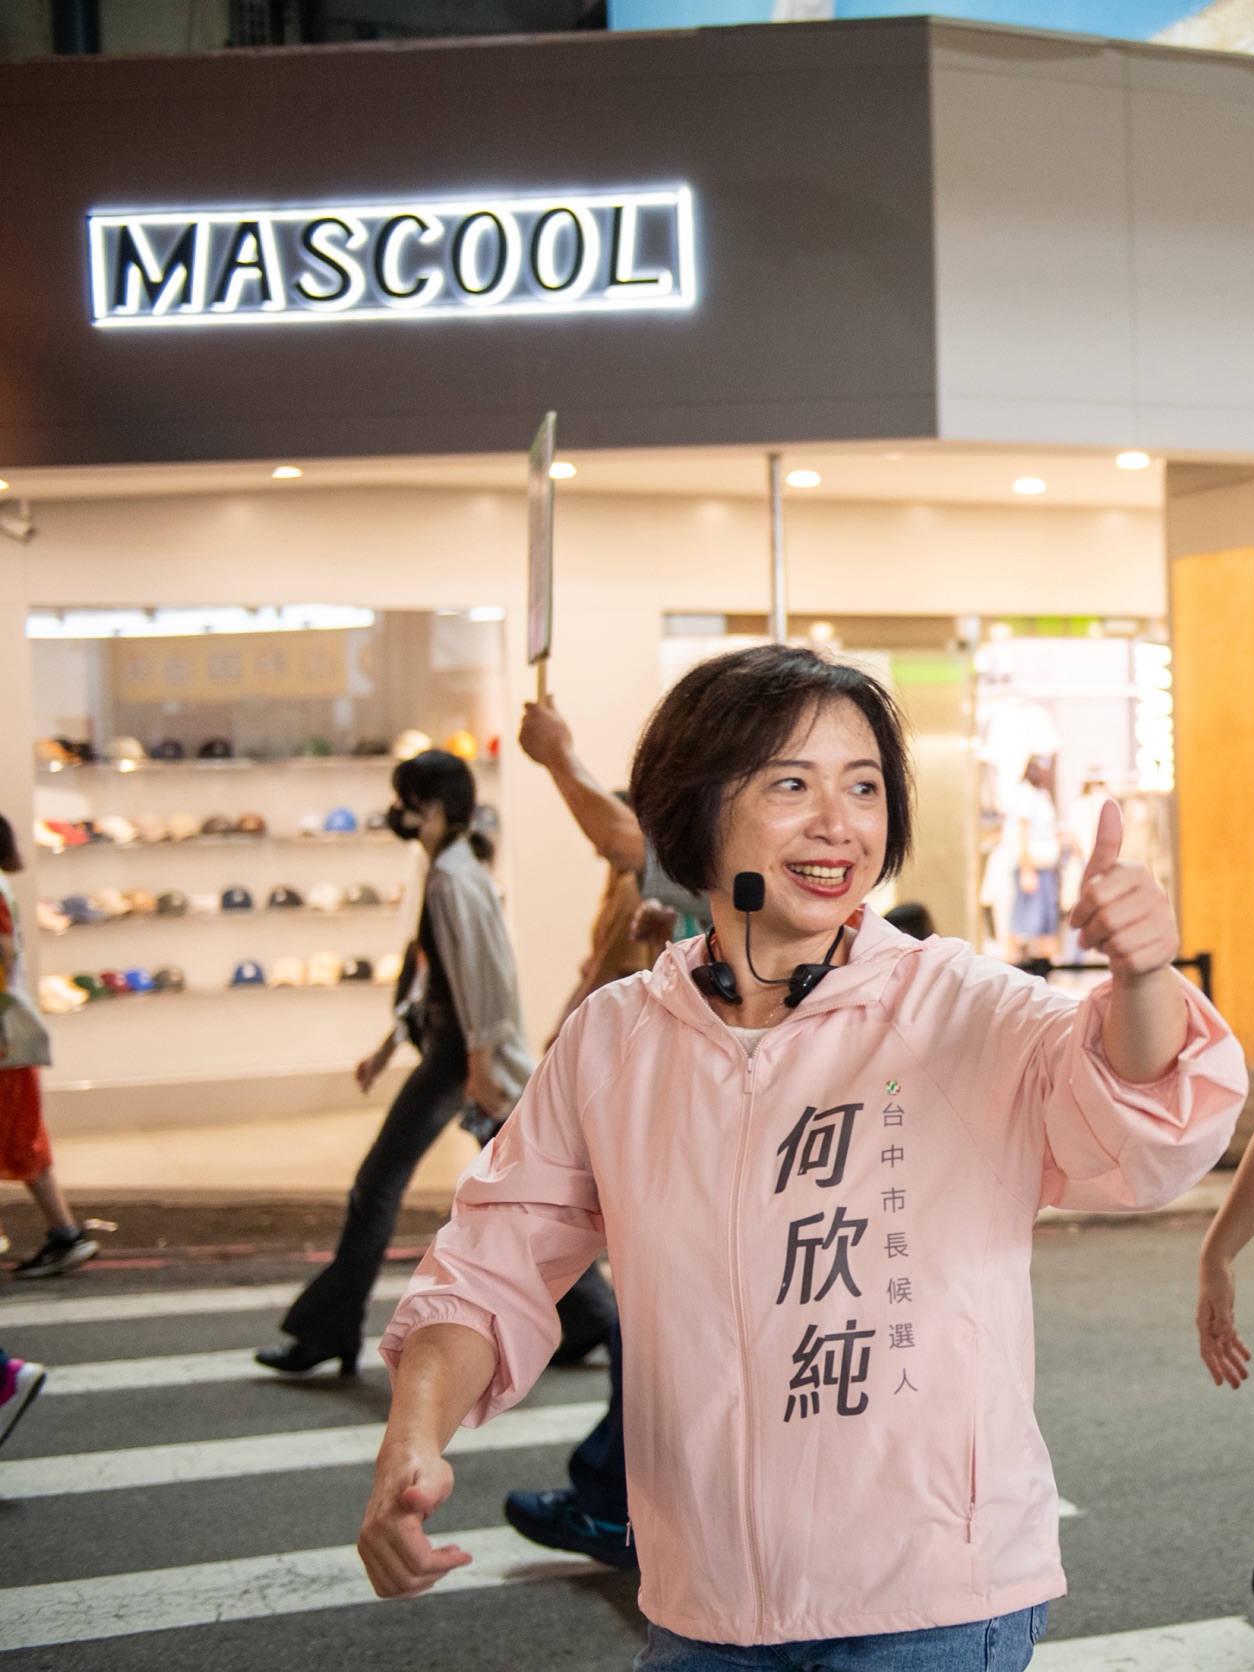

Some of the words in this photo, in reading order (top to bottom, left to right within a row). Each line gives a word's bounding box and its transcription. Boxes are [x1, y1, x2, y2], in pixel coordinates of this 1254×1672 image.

[113, 206, 670, 312] MASCOOL
[774, 1102, 876, 1423] 何欣純
[880, 1102, 919, 1396] 台中市長候選人
